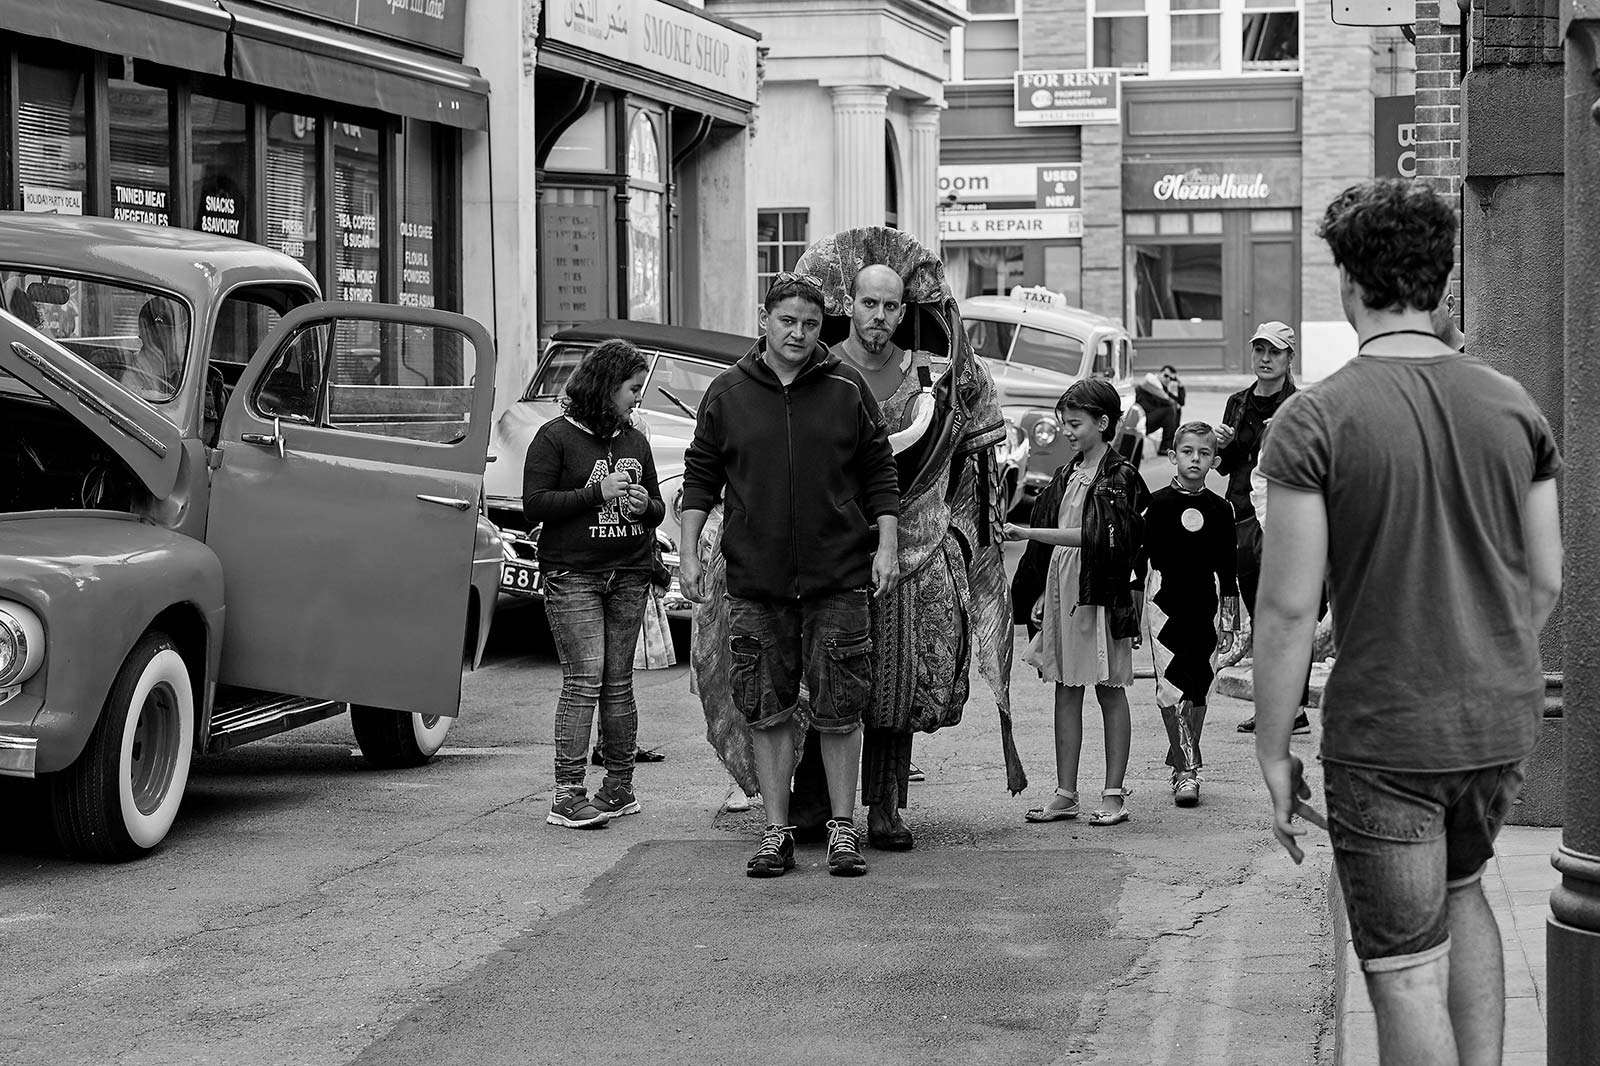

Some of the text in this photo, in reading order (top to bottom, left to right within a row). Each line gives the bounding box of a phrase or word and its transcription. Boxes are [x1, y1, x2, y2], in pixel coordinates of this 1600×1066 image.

[643, 13, 730, 78] SMOKE SHOP
[1022, 72, 1112, 88] FOR RENT
[1042, 169, 1078, 183] USED
[1054, 182, 1066, 194] &
[48, 195, 65, 207] PARTY
[65, 196, 81, 208] DEAL
[115, 185, 166, 209] TINNED MEAT
[205, 195, 235, 215] SNACKS
[1045, 195, 1076, 207] NEW
[338, 213, 376, 231] TEA, COFFEE
[971, 221, 980, 232] &
[986, 219, 1043, 232] REPAIR
[400, 222, 433, 240] OILS & GHEE
[343, 232, 371, 249] & SUGAR
[281, 241, 305, 257] FRUITS
[405, 251, 428, 267] FLOUR &
[356, 270, 378, 285] HONEY
[403, 269, 430, 285] POWDERS
[343, 287, 373, 302] & SYRUPS
[400, 292, 419, 307] SPICES
[1024, 292, 1052, 304] TAXI
[589, 525, 628, 538] TEAM
[502, 566, 541, 590] 681
